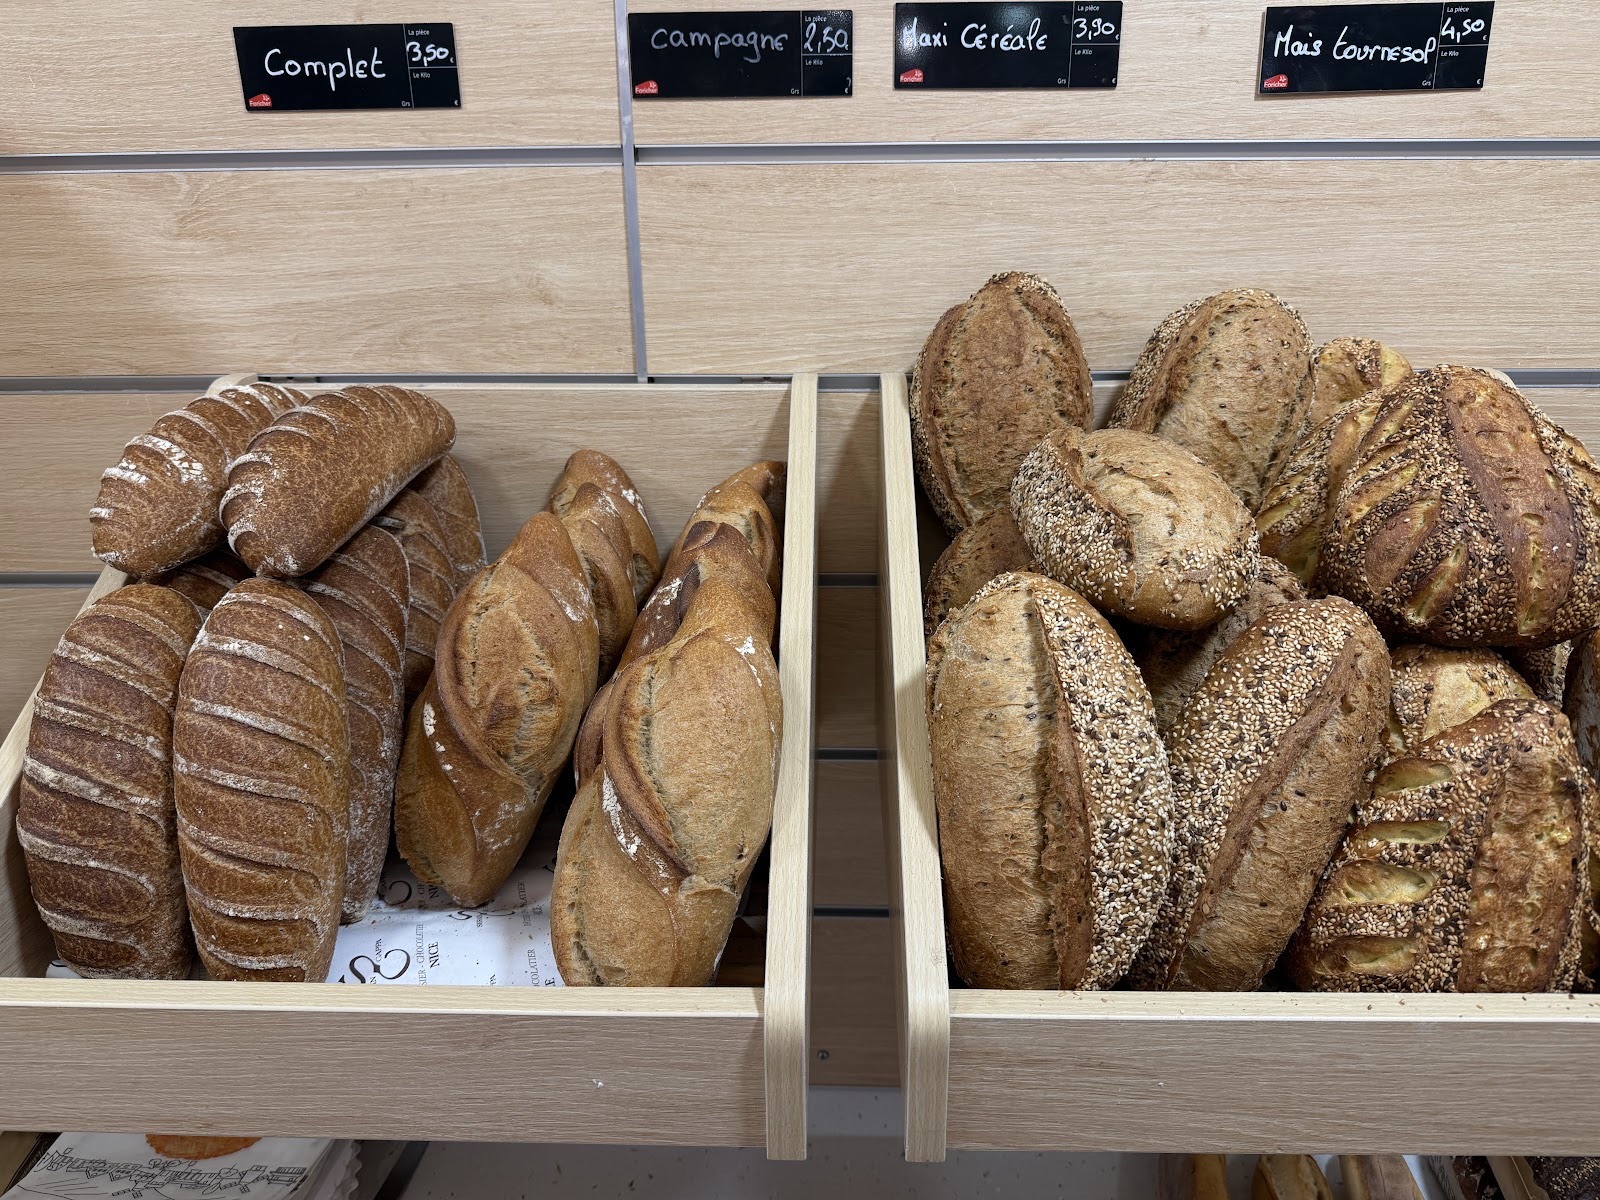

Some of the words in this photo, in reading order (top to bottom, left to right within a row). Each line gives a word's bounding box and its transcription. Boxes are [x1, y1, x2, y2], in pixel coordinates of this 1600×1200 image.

[813, 15, 827, 23] pièce
[1073, 17, 1115, 41] 3,90
[1441, 17, 1485, 43] 4,50
[416, 29, 430, 37] pièce
[804, 22, 848, 53] 2,50
[406, 41, 449, 67] 3,50
[264, 47, 386, 91] Complet
[900, 75, 924, 83] Foricher
[635, 87, 658, 95] Foricher
[428, 941, 440, 969] NICE
